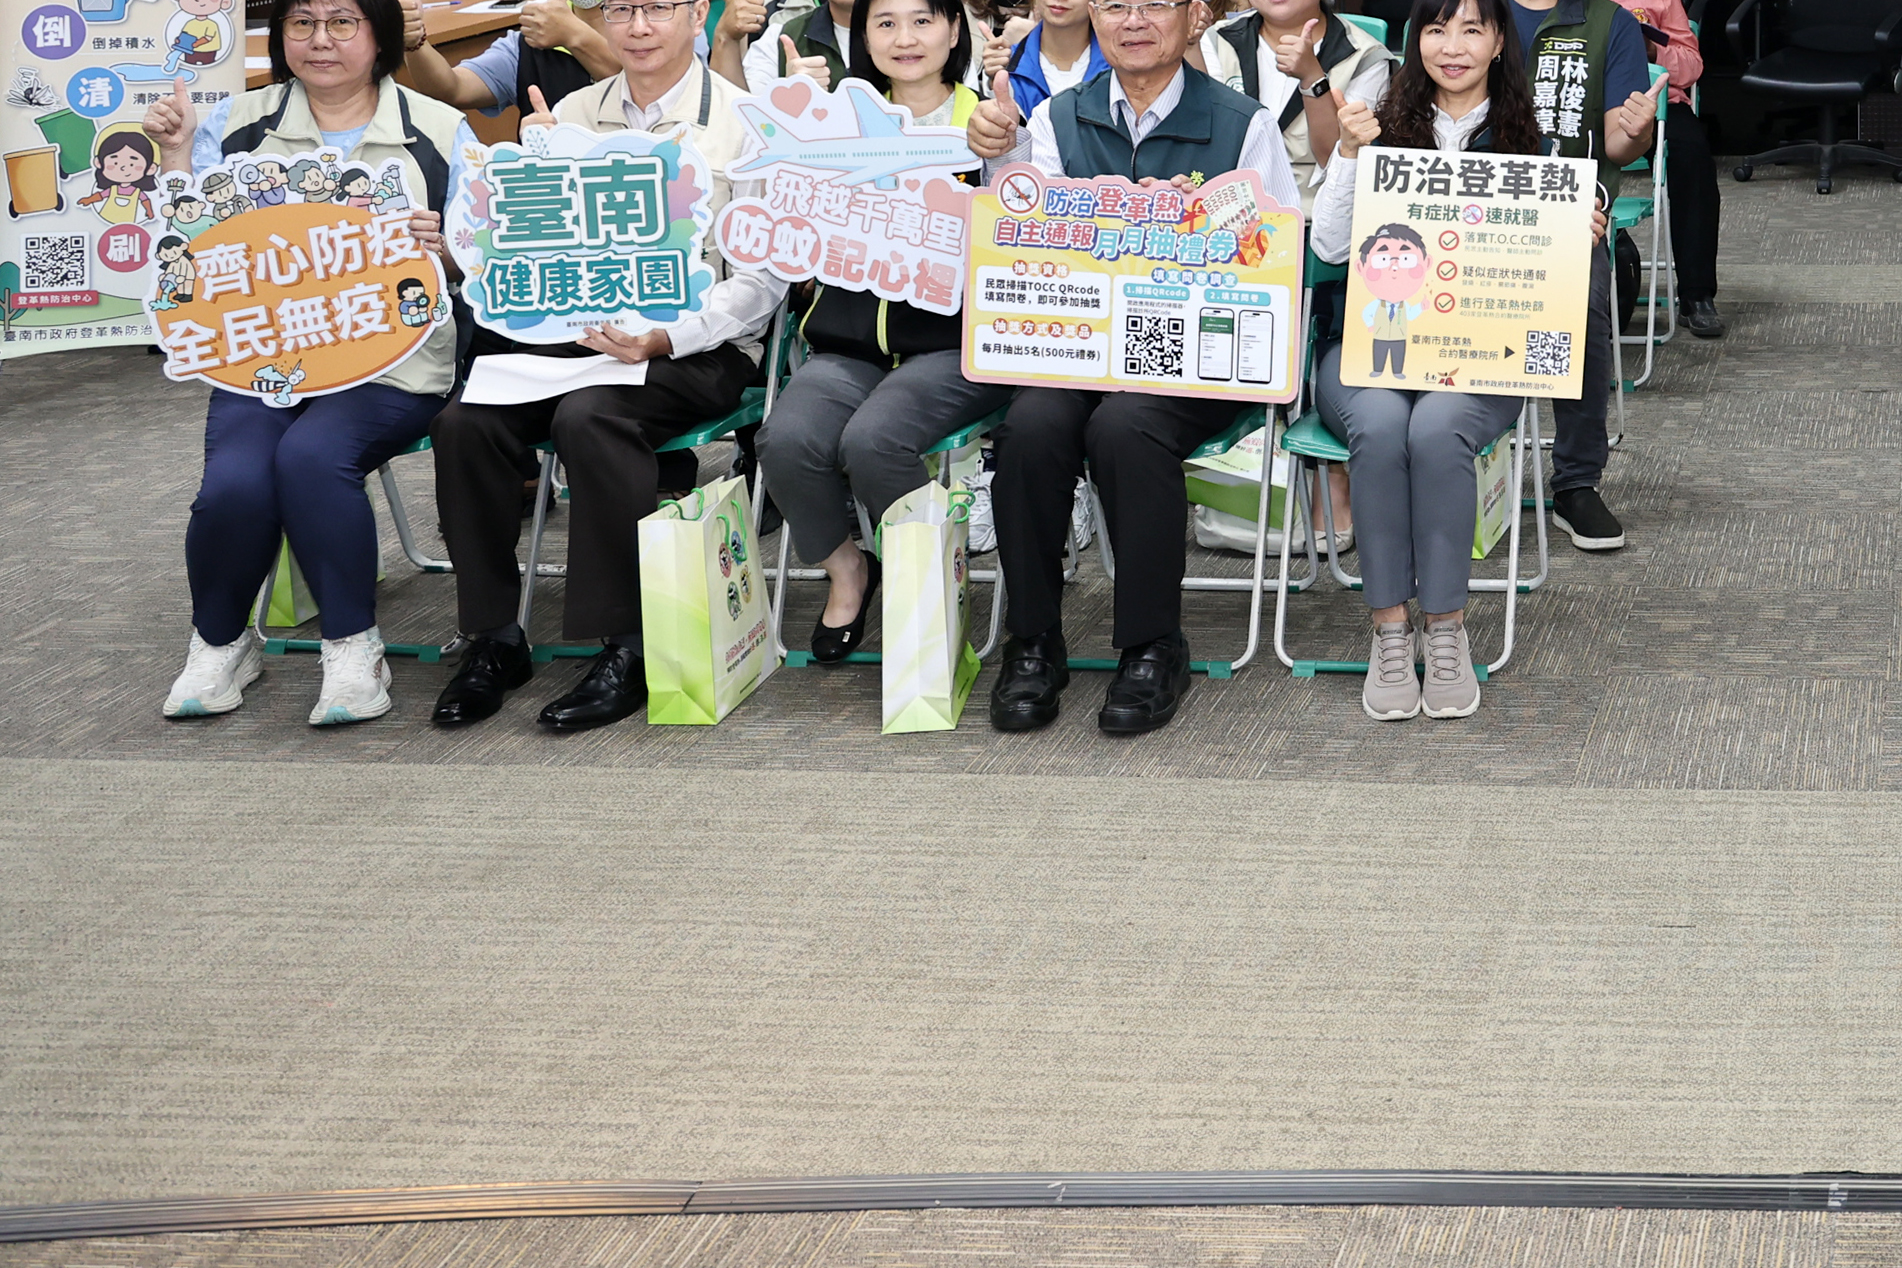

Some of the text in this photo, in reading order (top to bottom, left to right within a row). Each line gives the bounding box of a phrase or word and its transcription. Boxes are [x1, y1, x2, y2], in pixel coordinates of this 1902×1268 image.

[32, 14, 71, 49] 倒
[92, 36, 156, 50] 倒掉積水
[1554, 41, 1584, 50] DPP
[77, 77, 113, 109] 清
[1557, 57, 1589, 139] 林俊憲
[1373, 154, 1580, 203] 防治登革熱
[489, 156, 663, 246] 臺南
[771, 169, 965, 257] 飛越千萬里
[1044, 184, 1184, 223] 防治登革熱
[1407, 203, 1539, 227] 有症狀 速就醫
[106, 233, 142, 263] 刷
[193, 207, 426, 302] 齊心防疫
[994, 216, 1239, 266] 自主通報月月抽禮券
[726, 212, 958, 308] 防蚊記心裡
[1013, 260, 1069, 278] 抽獎資格
[1462, 265, 1546, 281] 疑似症狀快通報
[483, 253, 687, 312] 健康家園
[985, 278, 1100, 295] 民眾掃描TOCC QRcode
[1153, 268, 1237, 287] 填寫問卷調查
[18, 293, 93, 305] 登革熱防治中心
[1460, 296, 1545, 313] 進行登革熱快篩
[163, 281, 394, 376] 全民無疫
[994, 319, 1091, 339] 抽獎方式及獎品
[1411, 334, 1472, 347] 臺南市登革熱
[1438, 348, 1499, 361] 合約醫療院所
